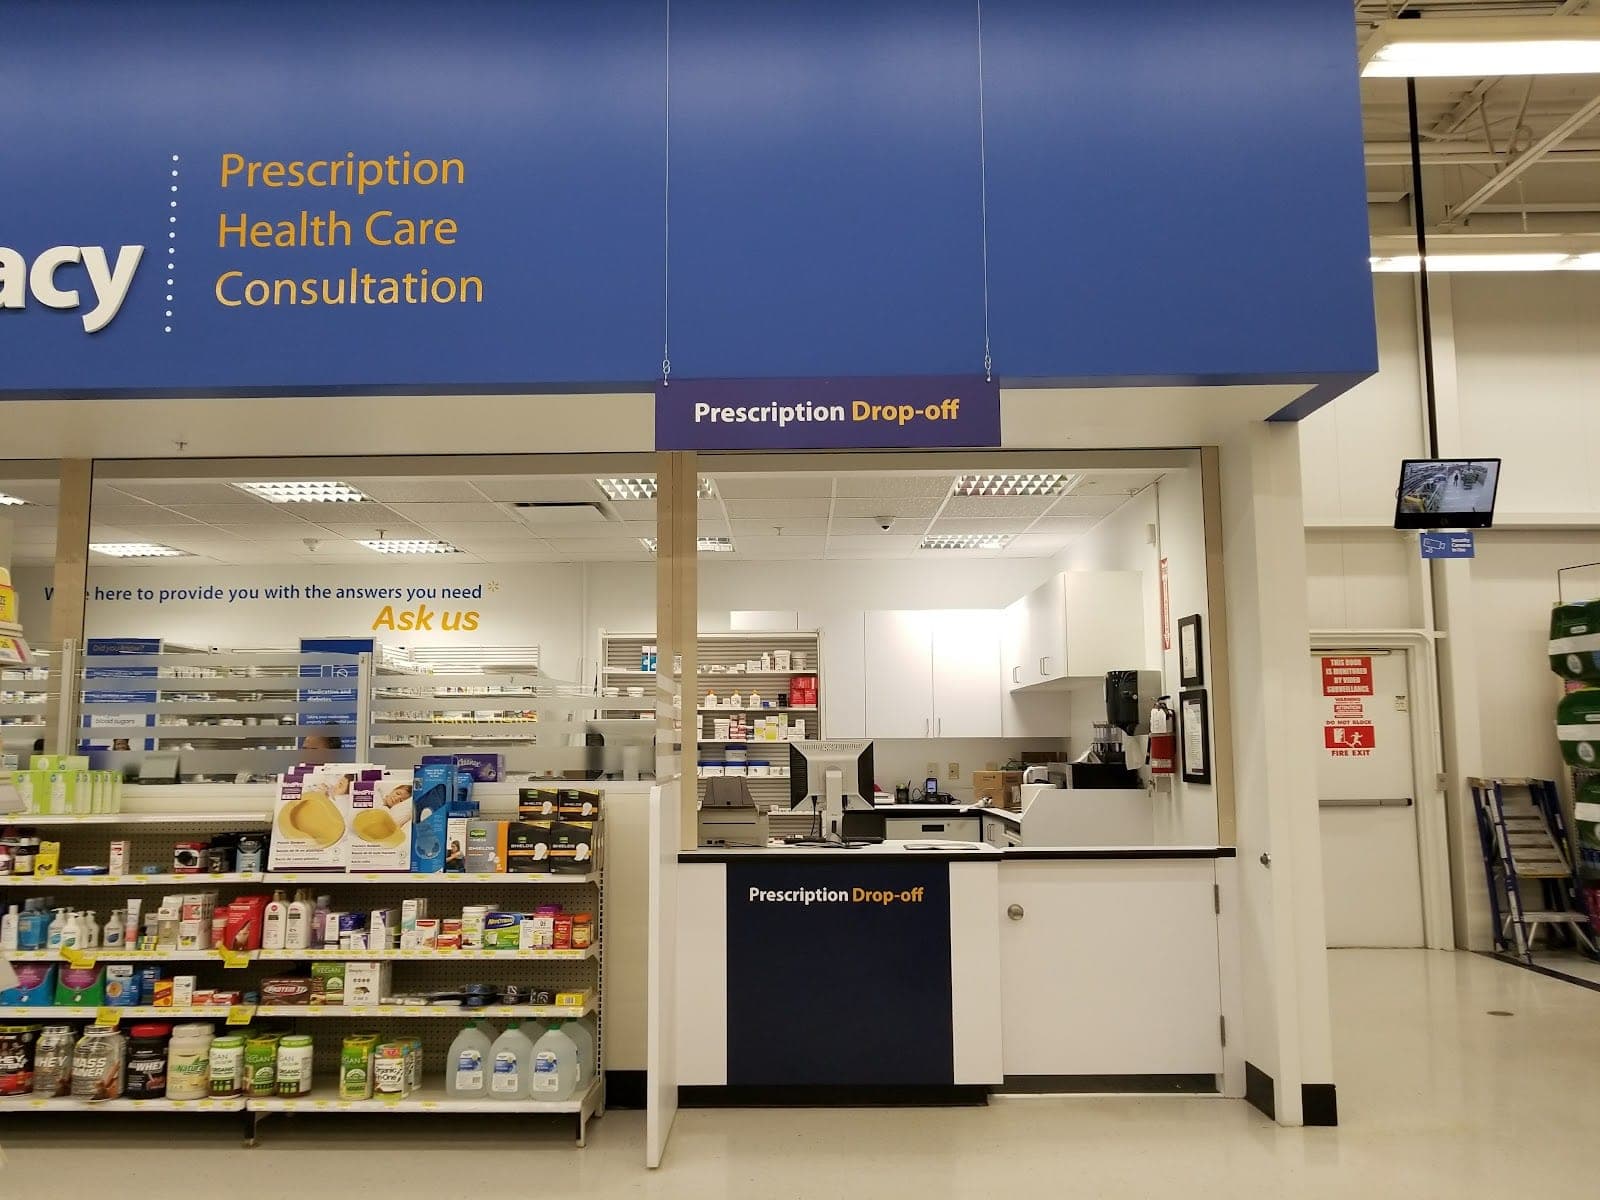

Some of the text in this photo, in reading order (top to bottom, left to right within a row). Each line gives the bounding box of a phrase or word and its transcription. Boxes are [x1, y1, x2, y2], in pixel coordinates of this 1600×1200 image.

[220, 150, 466, 196] Prescription
[217, 209, 459, 249] Health Care
[214, 267, 485, 308] Consultation
[694, 398, 961, 428] Prescription Drop-off
[95, 586, 132, 601] here
[138, 587, 154, 601] to
[159, 585, 224, 604] provide
[228, 587, 259, 603] you
[264, 584, 300, 599] with
[304, 584, 332, 599] the
[335, 586, 402, 599] answers
[406, 586, 436, 602] you
[441, 584, 482, 599] need
[371, 603, 480, 632] Ask us
[749, 886, 925, 906] Prescription Drop-off
[316, 966, 342, 974] VEGAN
